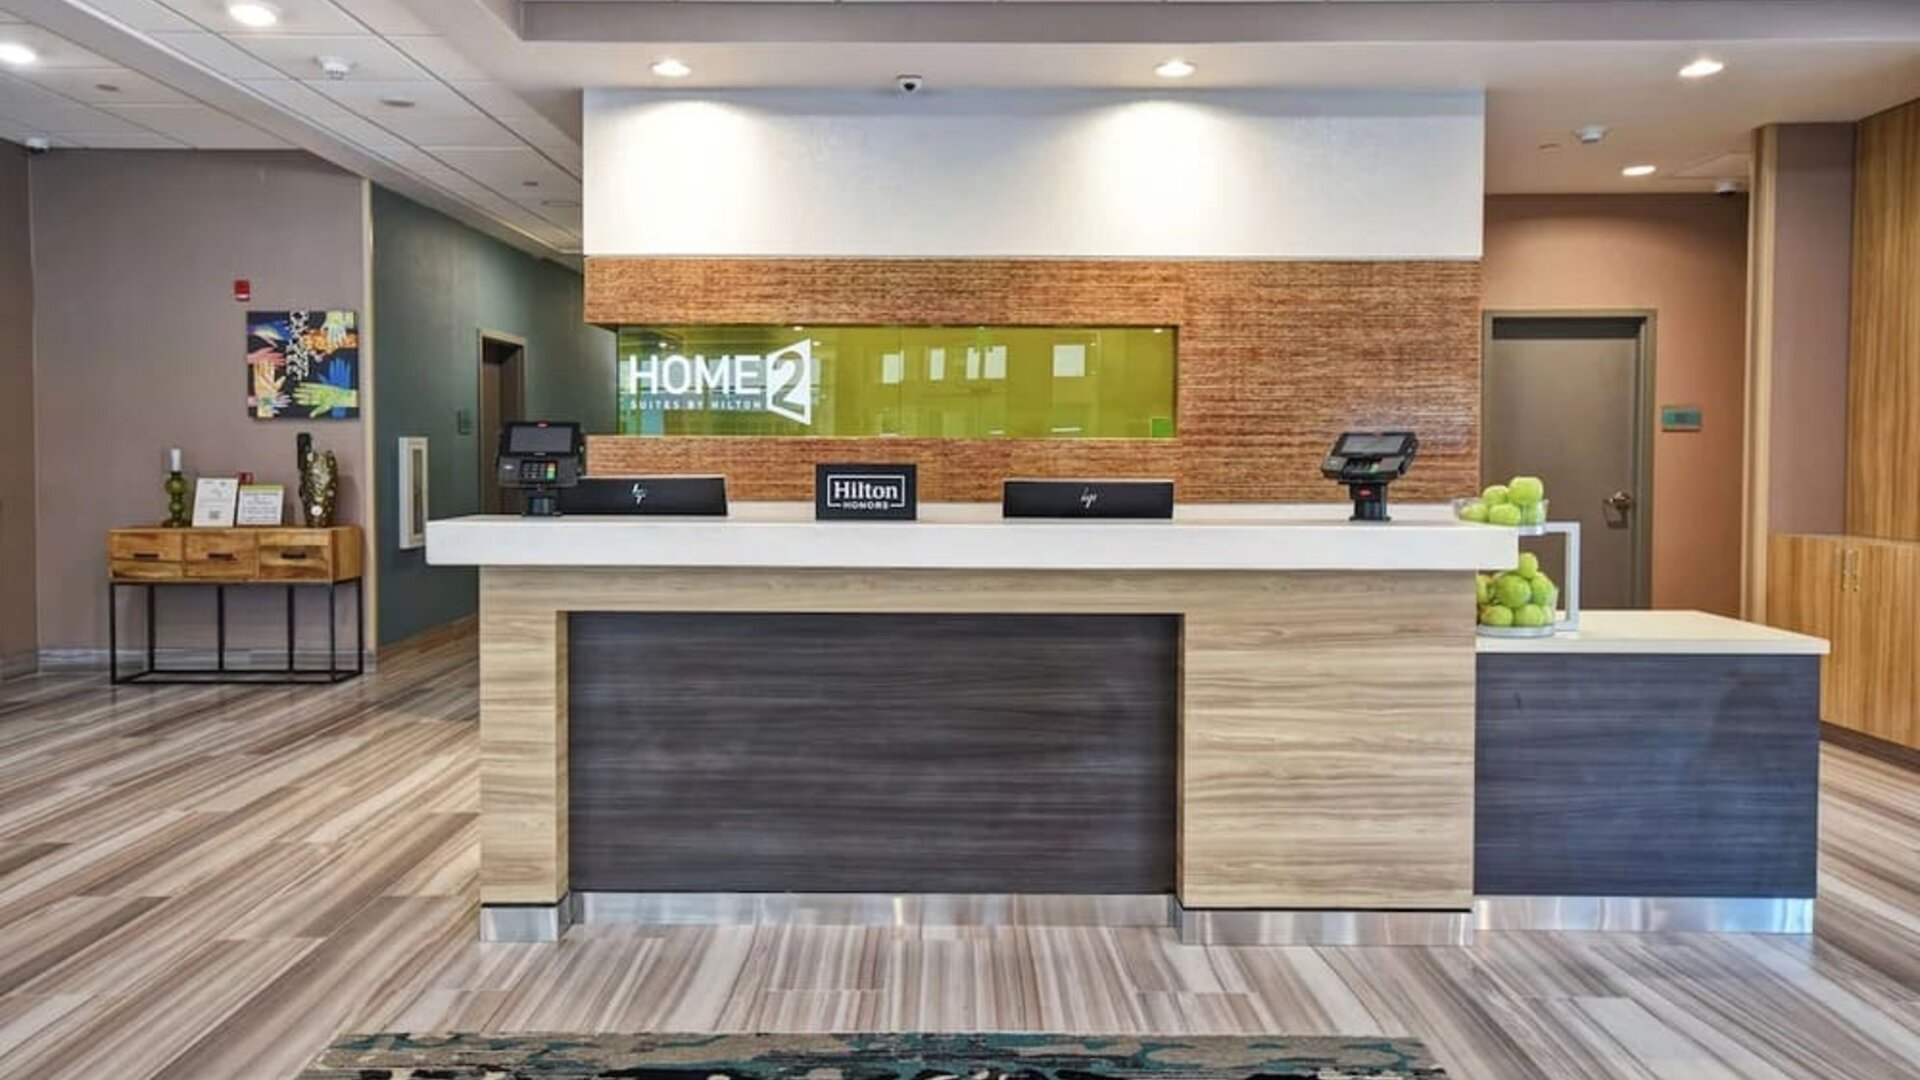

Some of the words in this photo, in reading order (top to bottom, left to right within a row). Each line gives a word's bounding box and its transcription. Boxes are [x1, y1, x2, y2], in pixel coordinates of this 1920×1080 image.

[630, 399, 680, 410] SUITES
[687, 399, 704, 410] BY
[711, 399, 762, 410] HILTON
[833, 481, 898, 499] Hilton
[843, 501, 889, 510] HONORS
